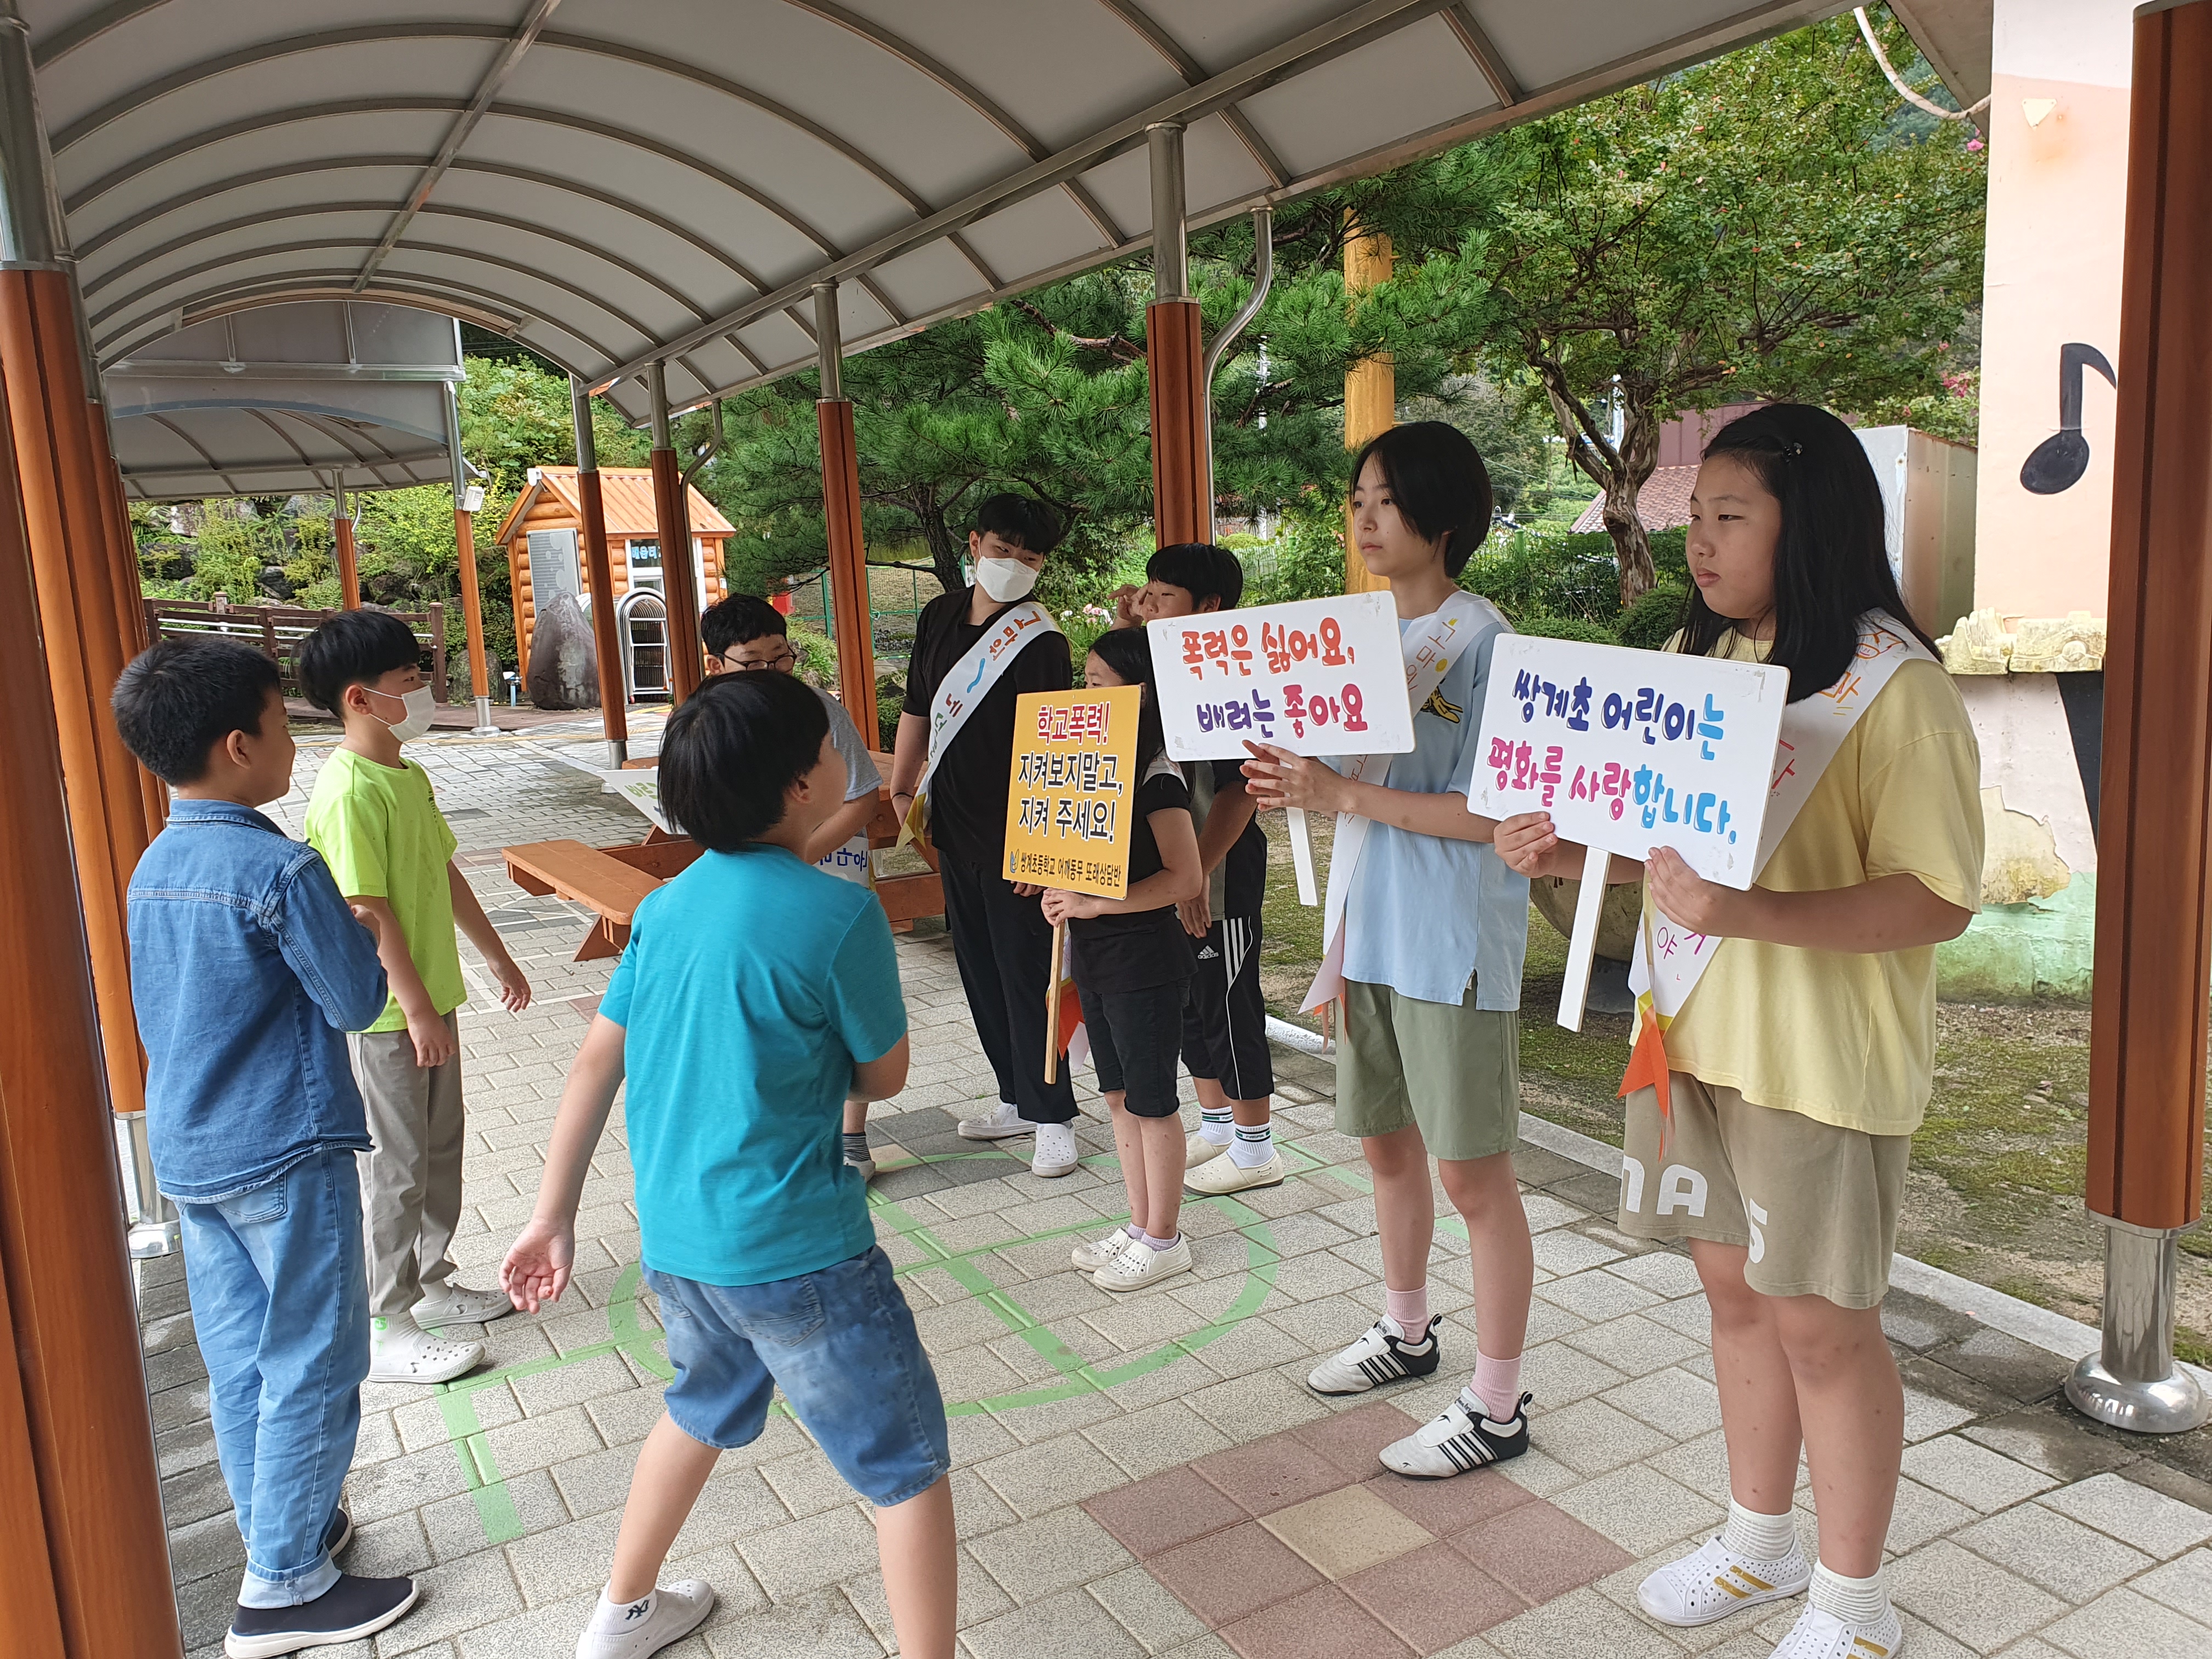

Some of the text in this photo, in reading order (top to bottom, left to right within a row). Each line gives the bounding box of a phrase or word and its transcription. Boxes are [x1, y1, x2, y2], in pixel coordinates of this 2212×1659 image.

[989, 611, 1041, 661] 고마워
[1181, 617, 1355, 680] 폭력은 싫어요,
[1037, 702, 1110, 744] 학교폭력!
[1196, 684, 1368, 739] 배려는 좋아요
[1511, 668, 1724, 760] 쌍계초 어린이는
[1018, 752, 1123, 795] 지켜보지말고,
[1486, 736, 1563, 807] 평화를
[1568, 761, 1737, 844] 사랑합니다.
[1019, 797, 1115, 842] 지켜 주세요!
[1020, 852, 1121, 887] 쌍계초등학교 어깨동무 또래상담반
